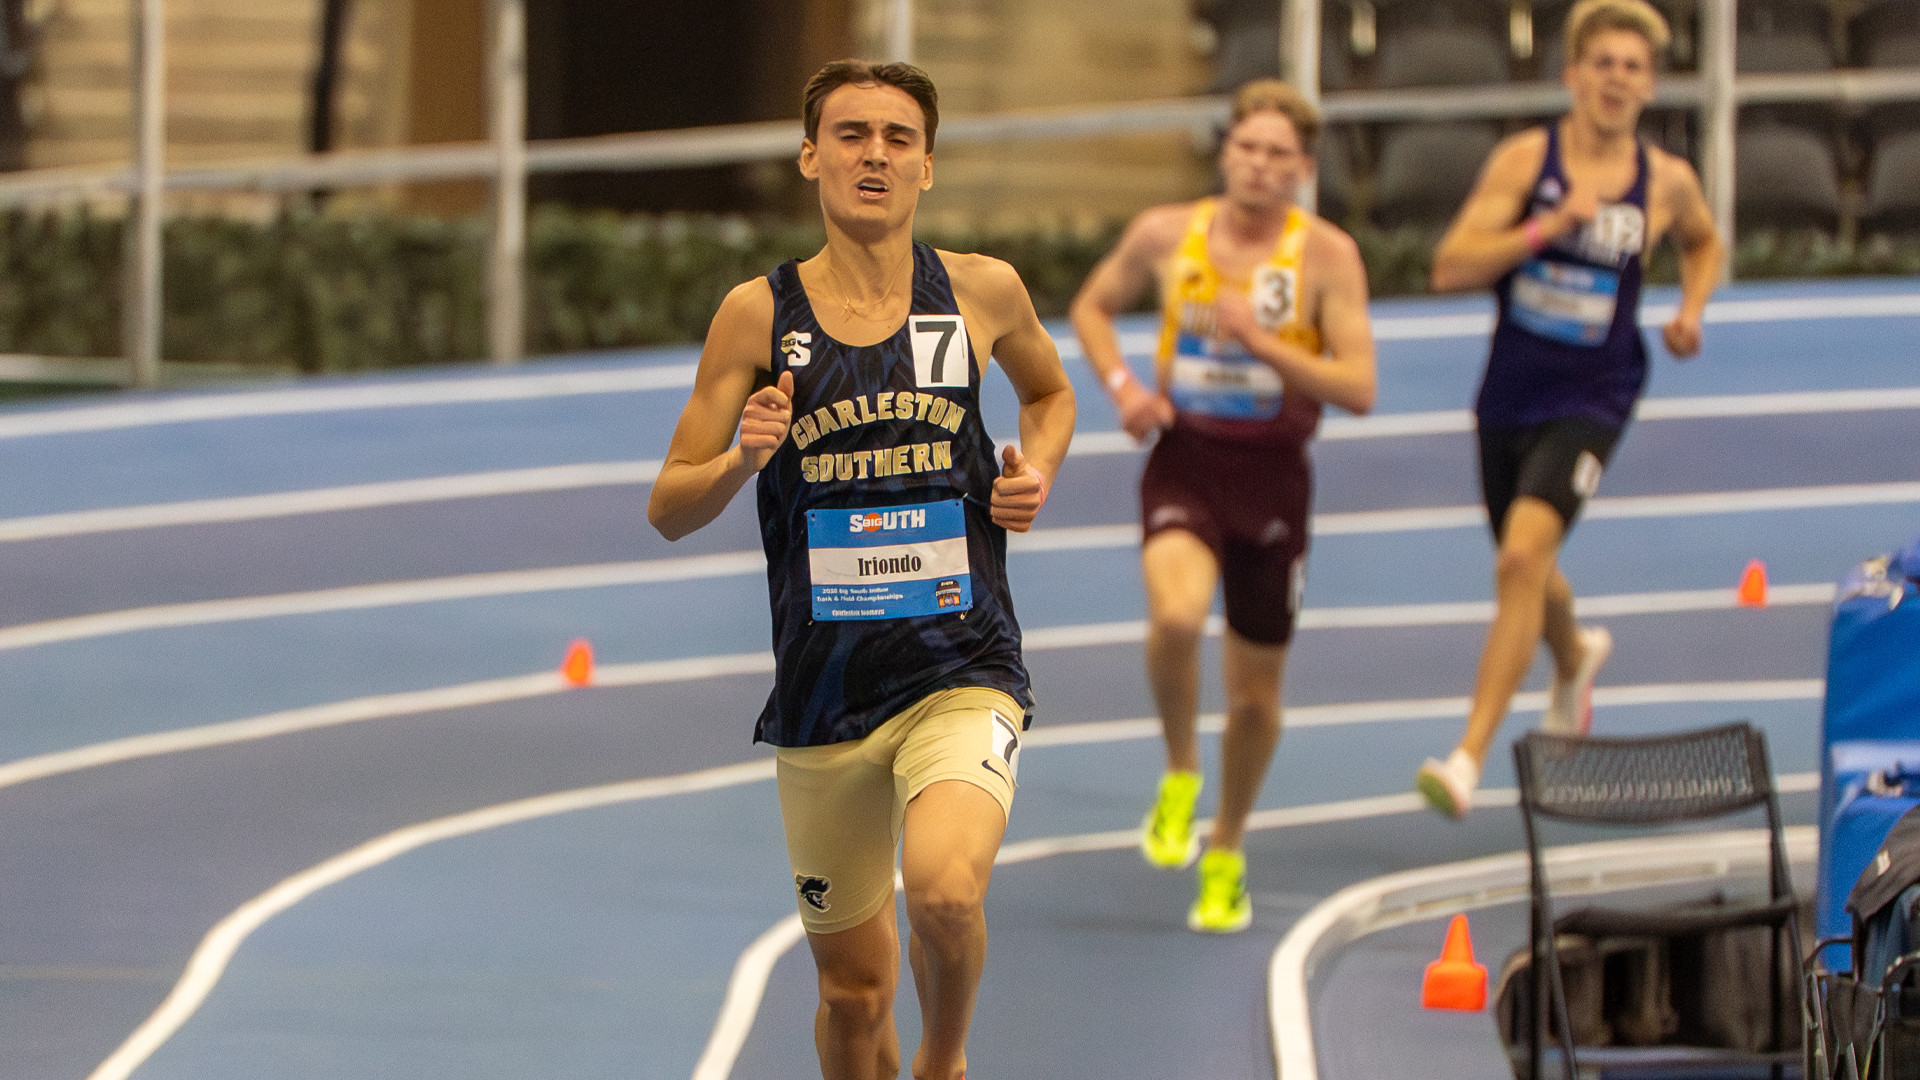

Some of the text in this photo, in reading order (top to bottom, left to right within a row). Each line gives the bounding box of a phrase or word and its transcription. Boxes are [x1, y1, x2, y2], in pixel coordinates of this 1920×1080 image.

[1264, 271, 1290, 318] 3
[916, 321, 957, 383] 7
[791, 391, 966, 450] CHARLESTON
[801, 441, 952, 483] SOUTHERN
[857, 554, 921, 577] Iriondo
[856, 594, 904, 602] Championships
[995, 715, 1018, 766] 7
